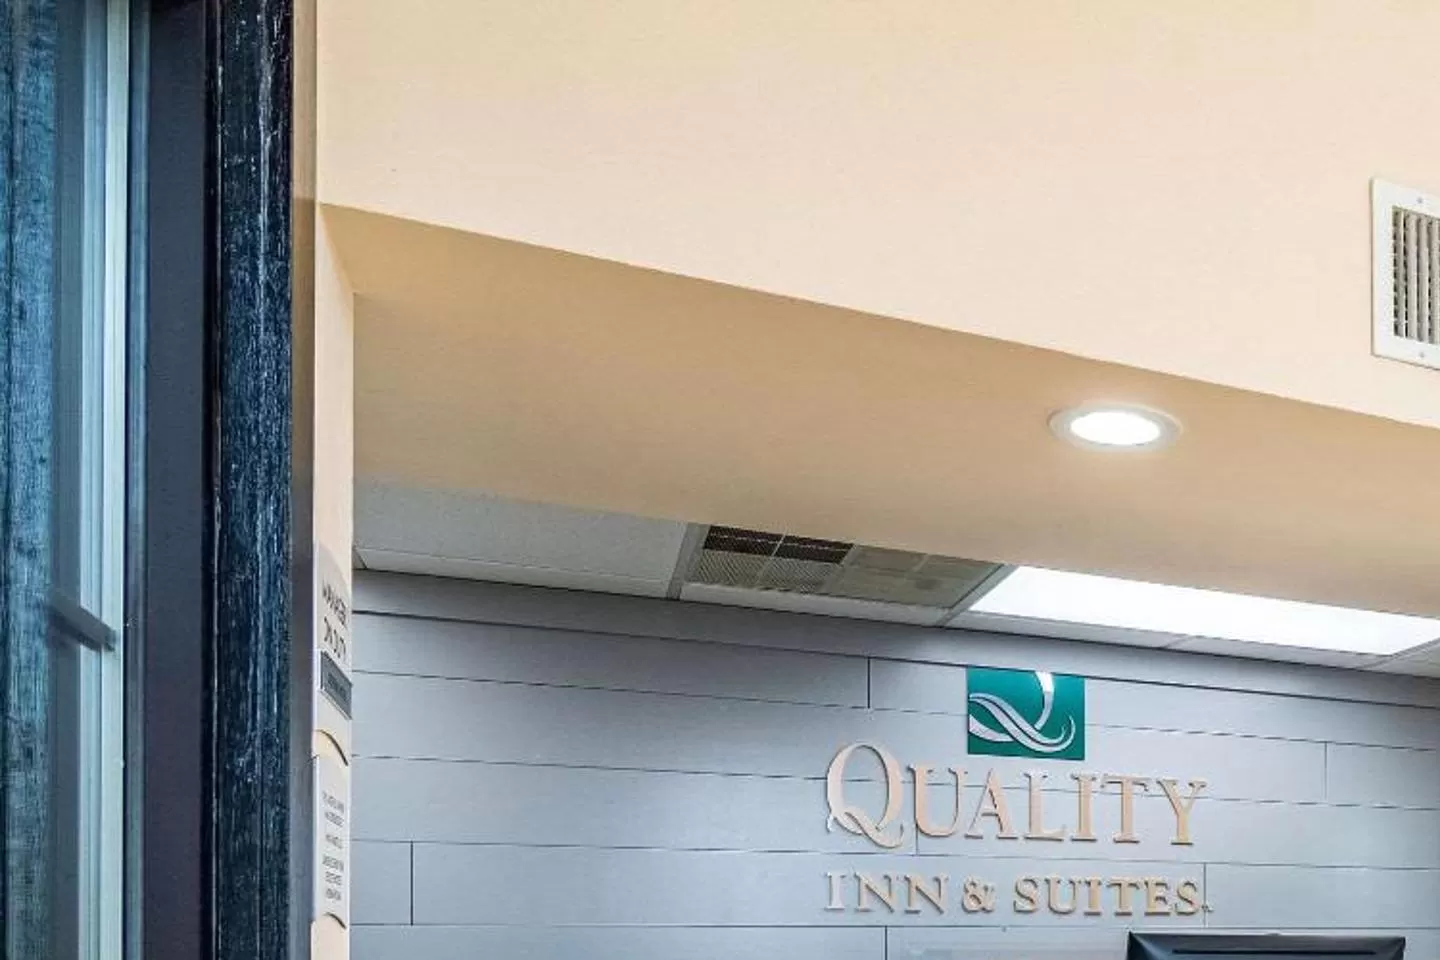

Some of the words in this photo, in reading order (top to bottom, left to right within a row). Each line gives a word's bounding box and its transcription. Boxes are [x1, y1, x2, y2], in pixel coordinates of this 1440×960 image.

[826, 739, 1208, 850] QUALITY
[824, 870, 949, 914] INN
[960, 875, 996, 914] &
[1013, 875, 1202, 917] SUITES
